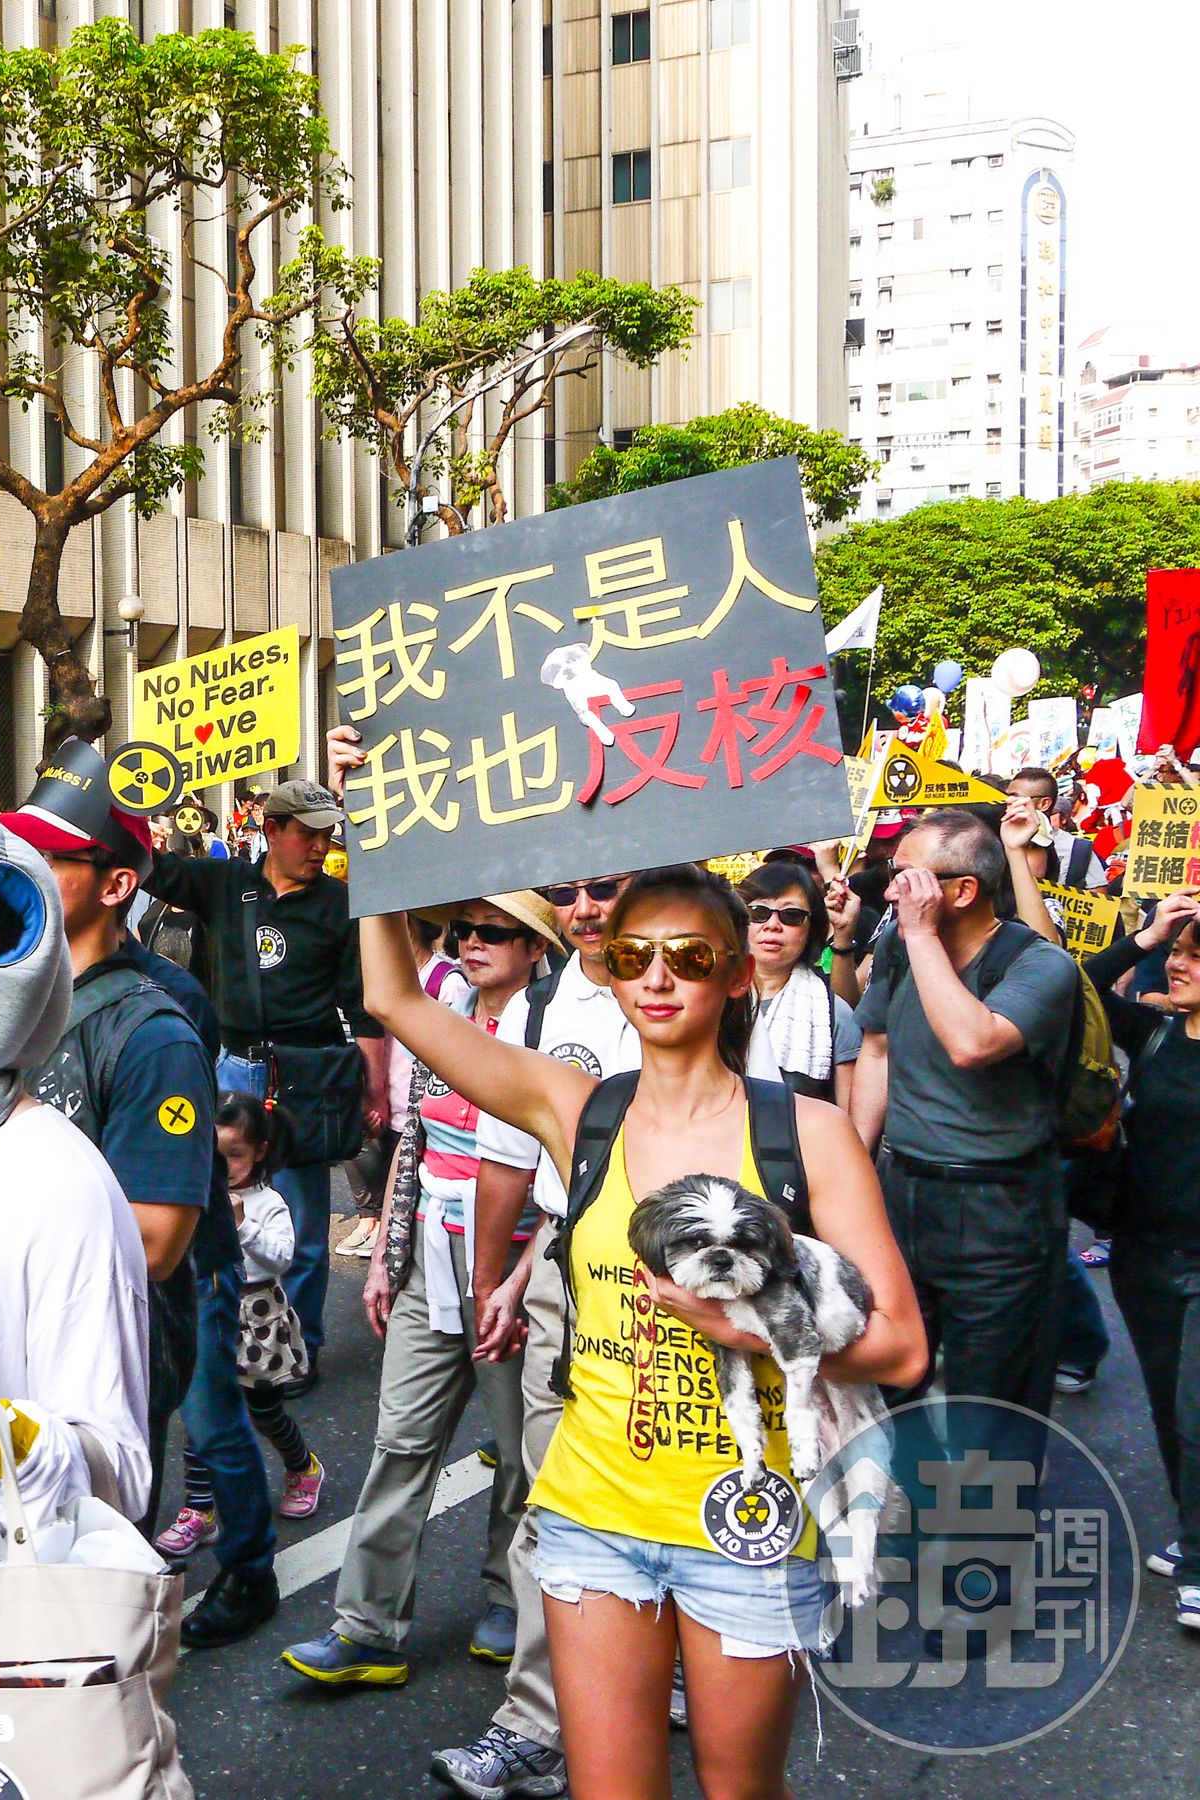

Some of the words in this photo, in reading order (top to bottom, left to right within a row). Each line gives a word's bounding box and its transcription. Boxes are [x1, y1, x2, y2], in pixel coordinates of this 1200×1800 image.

[334, 520, 819, 721] 我不是人
[144, 675, 180, 701] No
[190, 644, 289, 688] Nukes,
[157, 698, 194, 725] No
[204, 675, 275, 711] Fear.
[180, 738, 276, 783] aiwan
[345, 656, 843, 852] 我也反核
[1051, 892, 1094, 917] UKES
[552, 1045, 570, 1059] NO
[572, 1045, 601, 1075] NUKE
[638, 1372, 715, 1401] KIDS
[711, 1480, 737, 1505] NO
[714, 1527, 742, 1553] NO
[747, 1524, 793, 1559] FEAR
